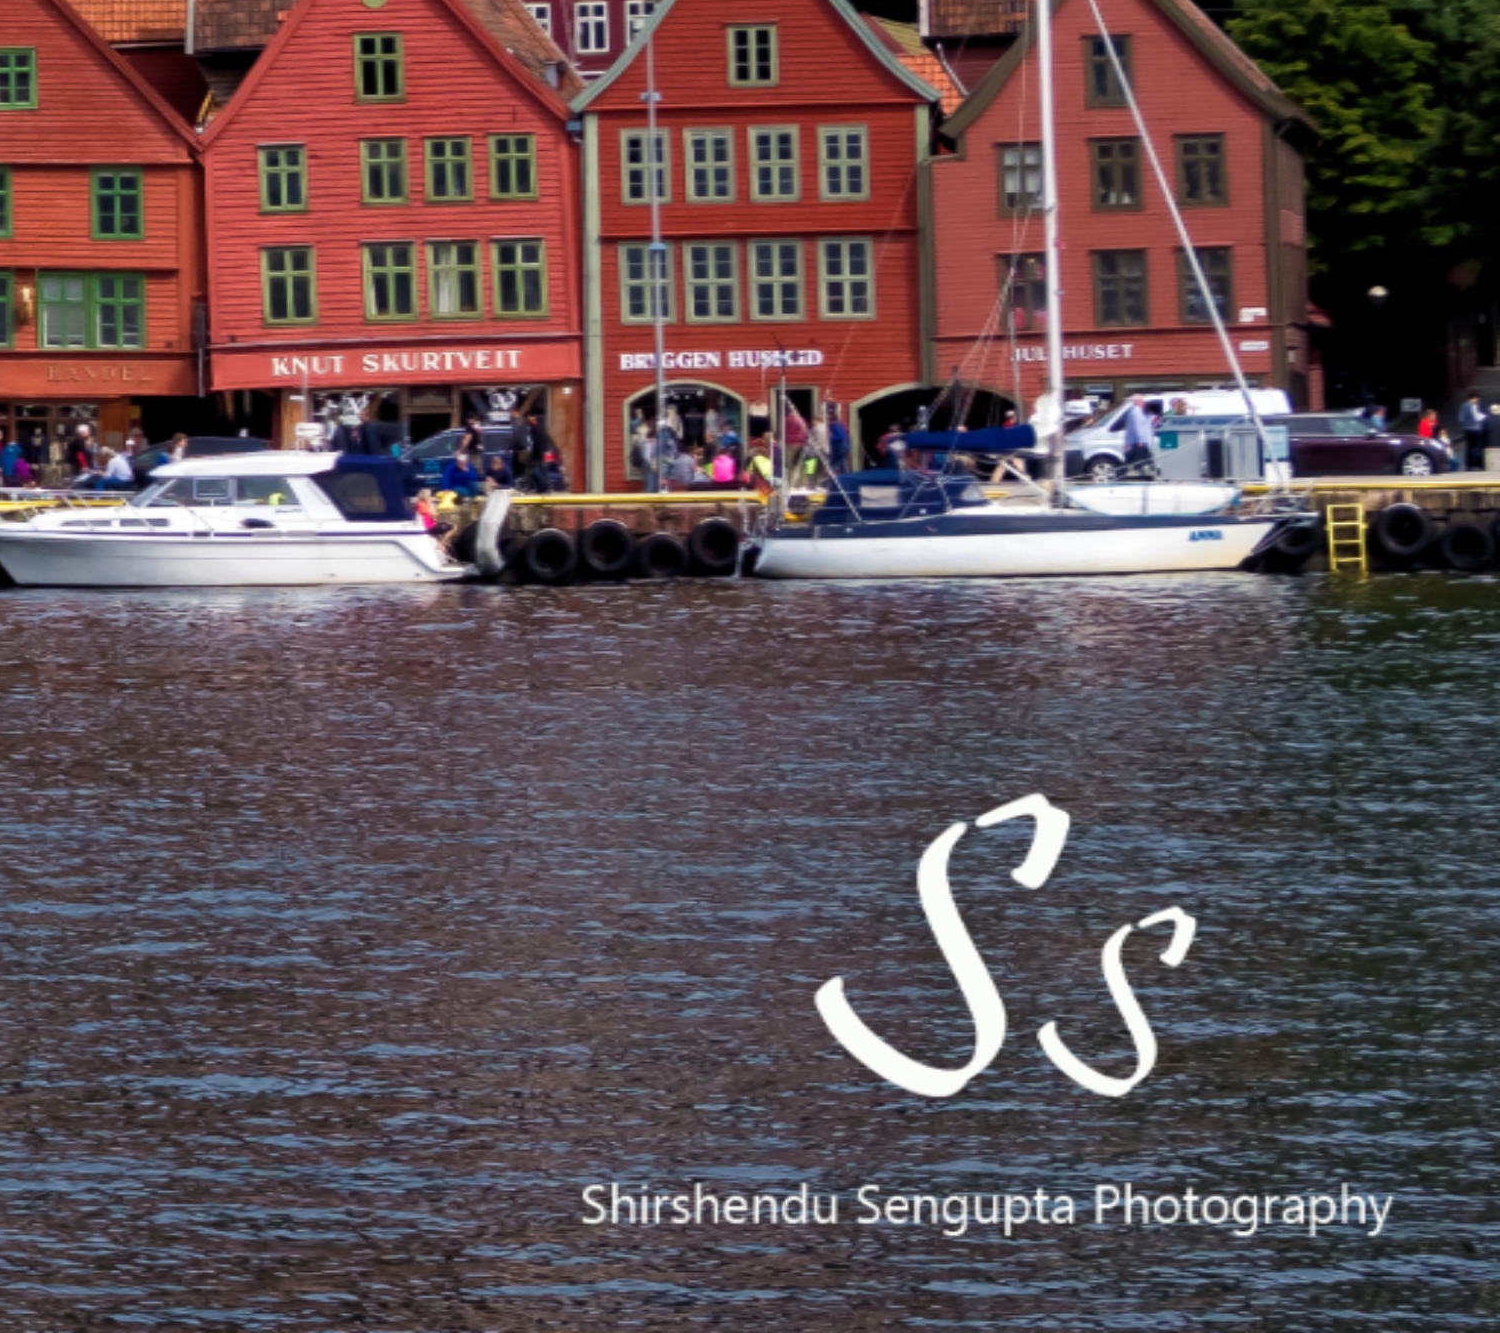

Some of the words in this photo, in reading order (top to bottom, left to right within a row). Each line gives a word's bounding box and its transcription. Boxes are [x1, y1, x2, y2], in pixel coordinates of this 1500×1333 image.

[1010, 343, 1134, 362] JULHUSET
[272, 355, 345, 376] KNUT
[362, 349, 522, 373] SKURTVEIT
[48, 364, 153, 382] HANDEL
